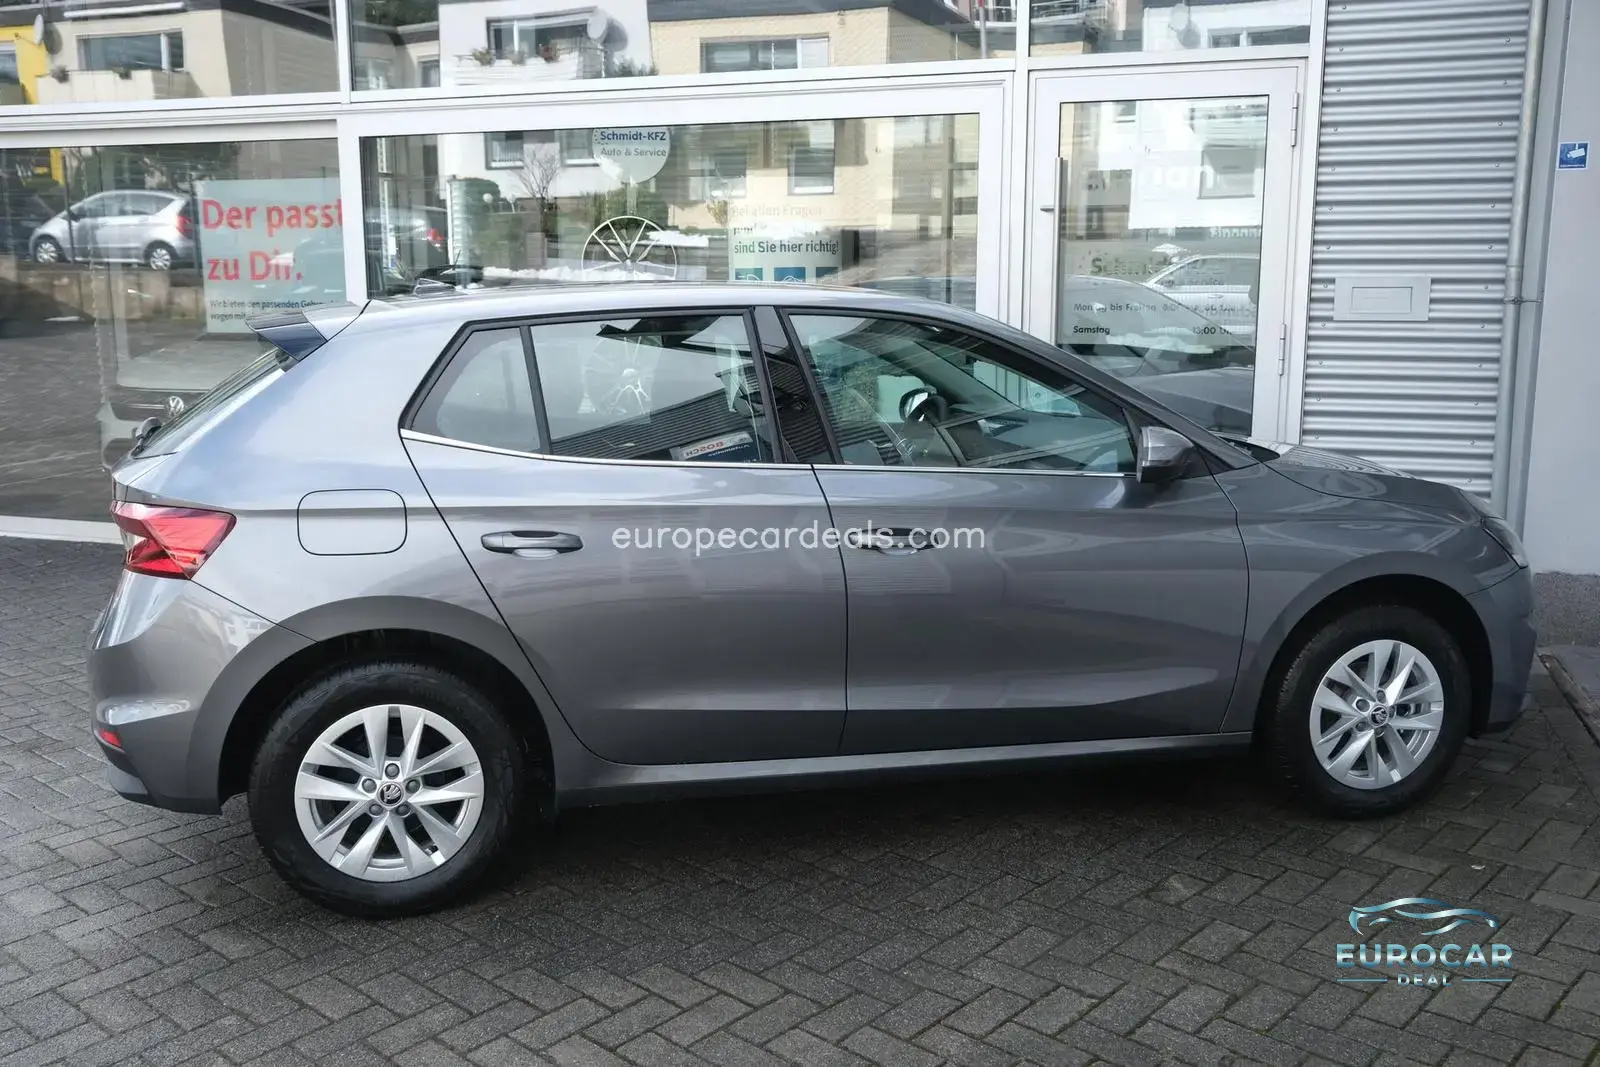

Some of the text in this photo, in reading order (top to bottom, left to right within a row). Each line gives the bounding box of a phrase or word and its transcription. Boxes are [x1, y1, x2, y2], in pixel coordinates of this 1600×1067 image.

[600, 130, 666, 141] Schmidt-KFZ
[601, 147, 622, 157] Auto
[634, 147, 666, 157] Service
[202, 198, 343, 237] Der passt
[734, 240, 839, 255] sind Sie hier richtig!
[207, 258, 241, 281] zu
[262, 300, 299, 310] passenden
[1073, 303, 1107, 313] Monag
[1110, 303, 1123, 312] bis
[1073, 325, 1110, 335] Samstag
